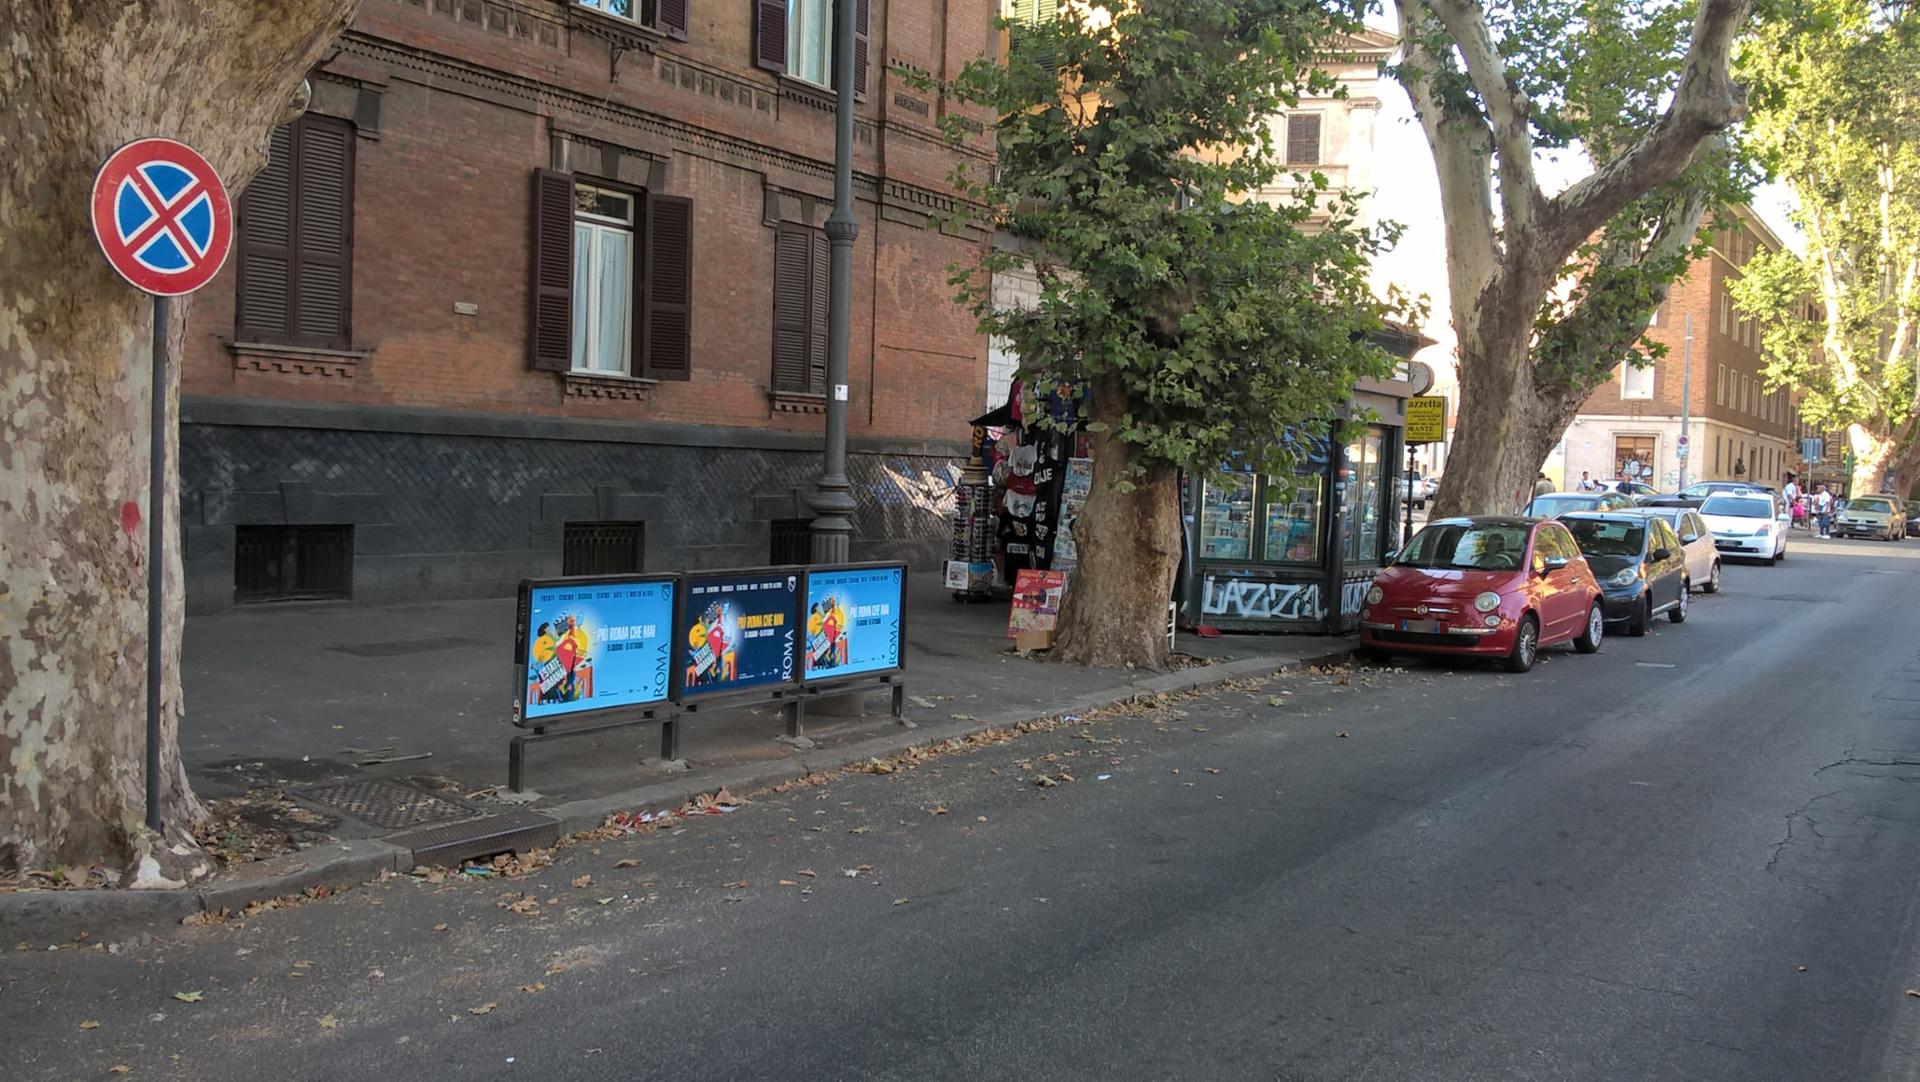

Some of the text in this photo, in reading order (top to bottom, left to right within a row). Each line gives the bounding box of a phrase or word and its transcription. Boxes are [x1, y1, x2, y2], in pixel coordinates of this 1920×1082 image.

[598, 624, 656, 642] PIÙ ROMA CHE MAI
[747, 614, 762, 629] ROMA
[763, 613, 774, 627] CHE
[774, 613, 785, 626] MAI
[889, 618, 898, 665] ROMA
[653, 642, 668, 697] ROMA
[782, 629, 794, 680] ROMA
